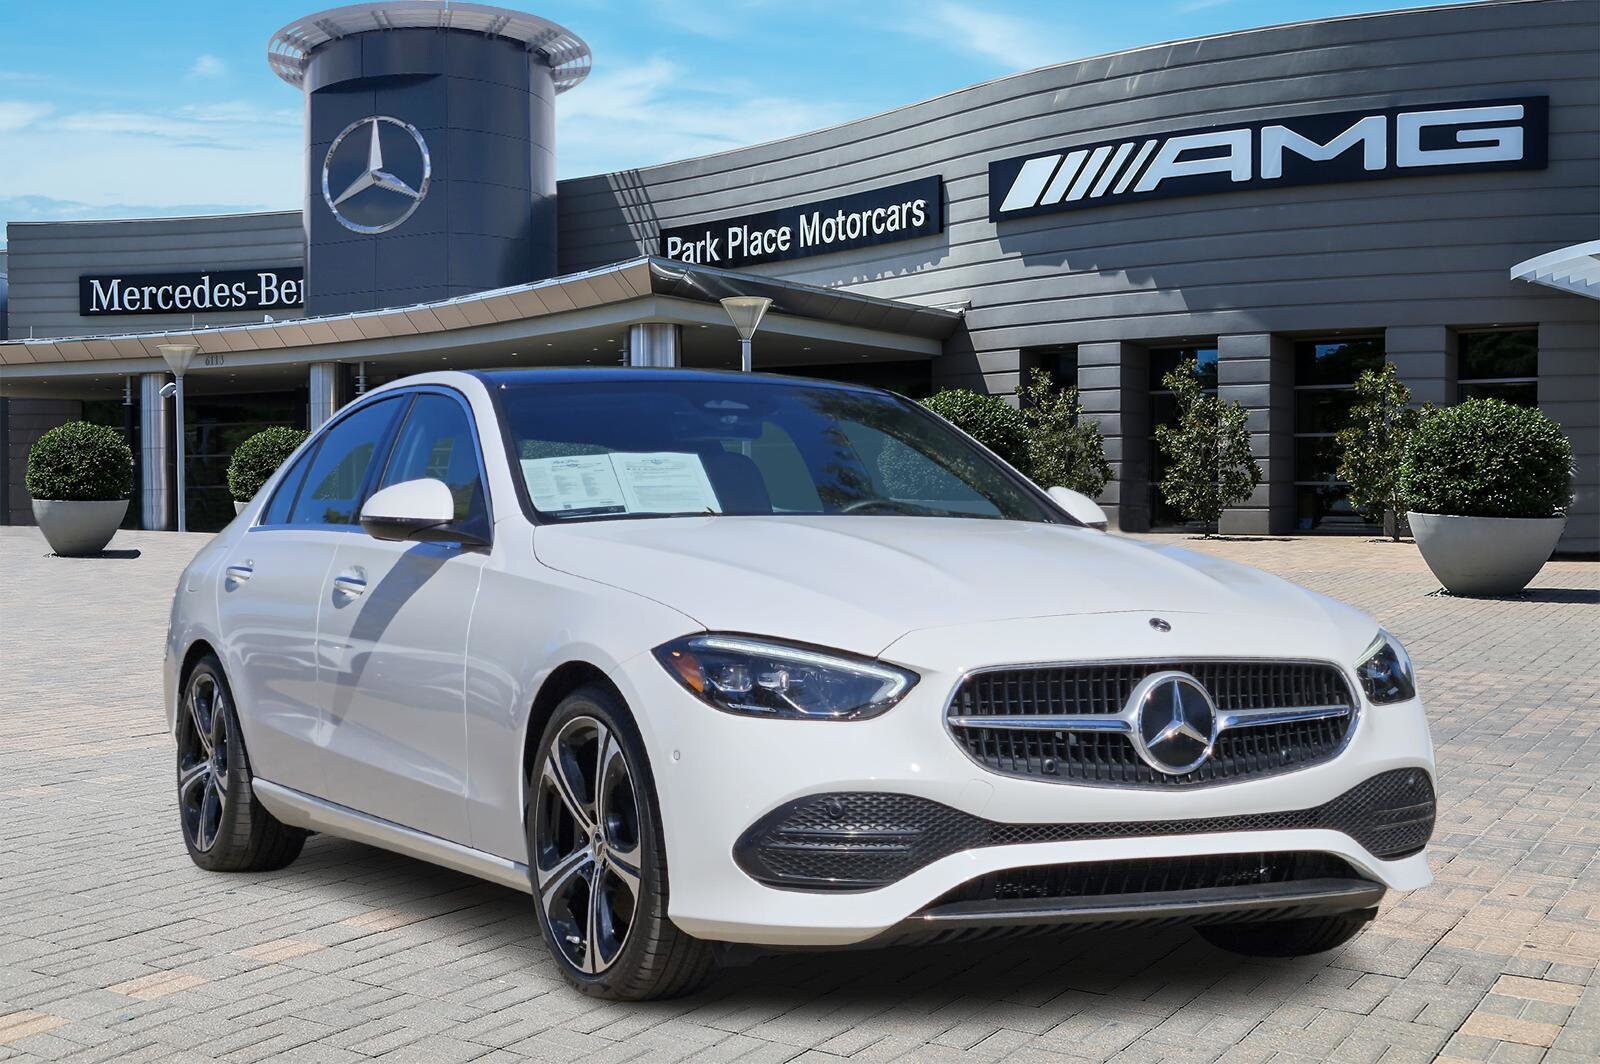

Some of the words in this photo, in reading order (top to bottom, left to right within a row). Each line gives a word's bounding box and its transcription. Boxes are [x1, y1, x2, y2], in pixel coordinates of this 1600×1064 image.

[1133, 104, 1524, 193] AMG
[667, 230, 721, 265] Park
[727, 225, 792, 259] Place
[799, 199, 928, 248] Motorcars
